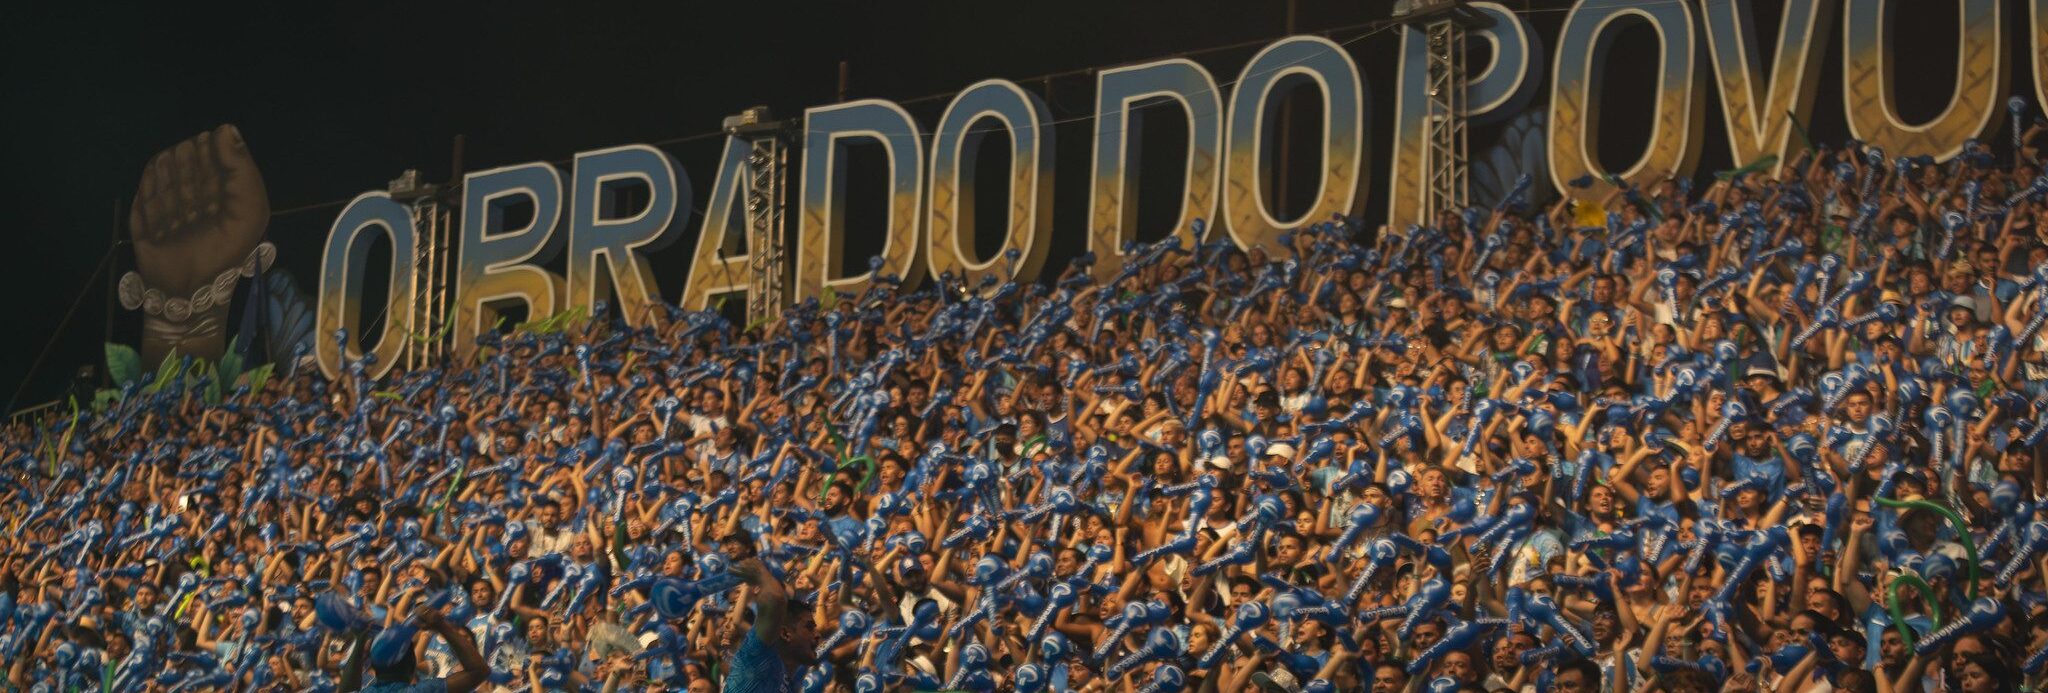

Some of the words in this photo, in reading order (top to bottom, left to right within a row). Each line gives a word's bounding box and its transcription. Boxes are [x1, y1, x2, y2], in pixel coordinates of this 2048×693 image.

[316, 190, 416, 383] O
[453, 78, 1041, 352] BRADO
[1087, 34, 1364, 272] DO
[1387, 0, 2000, 236] POVO
